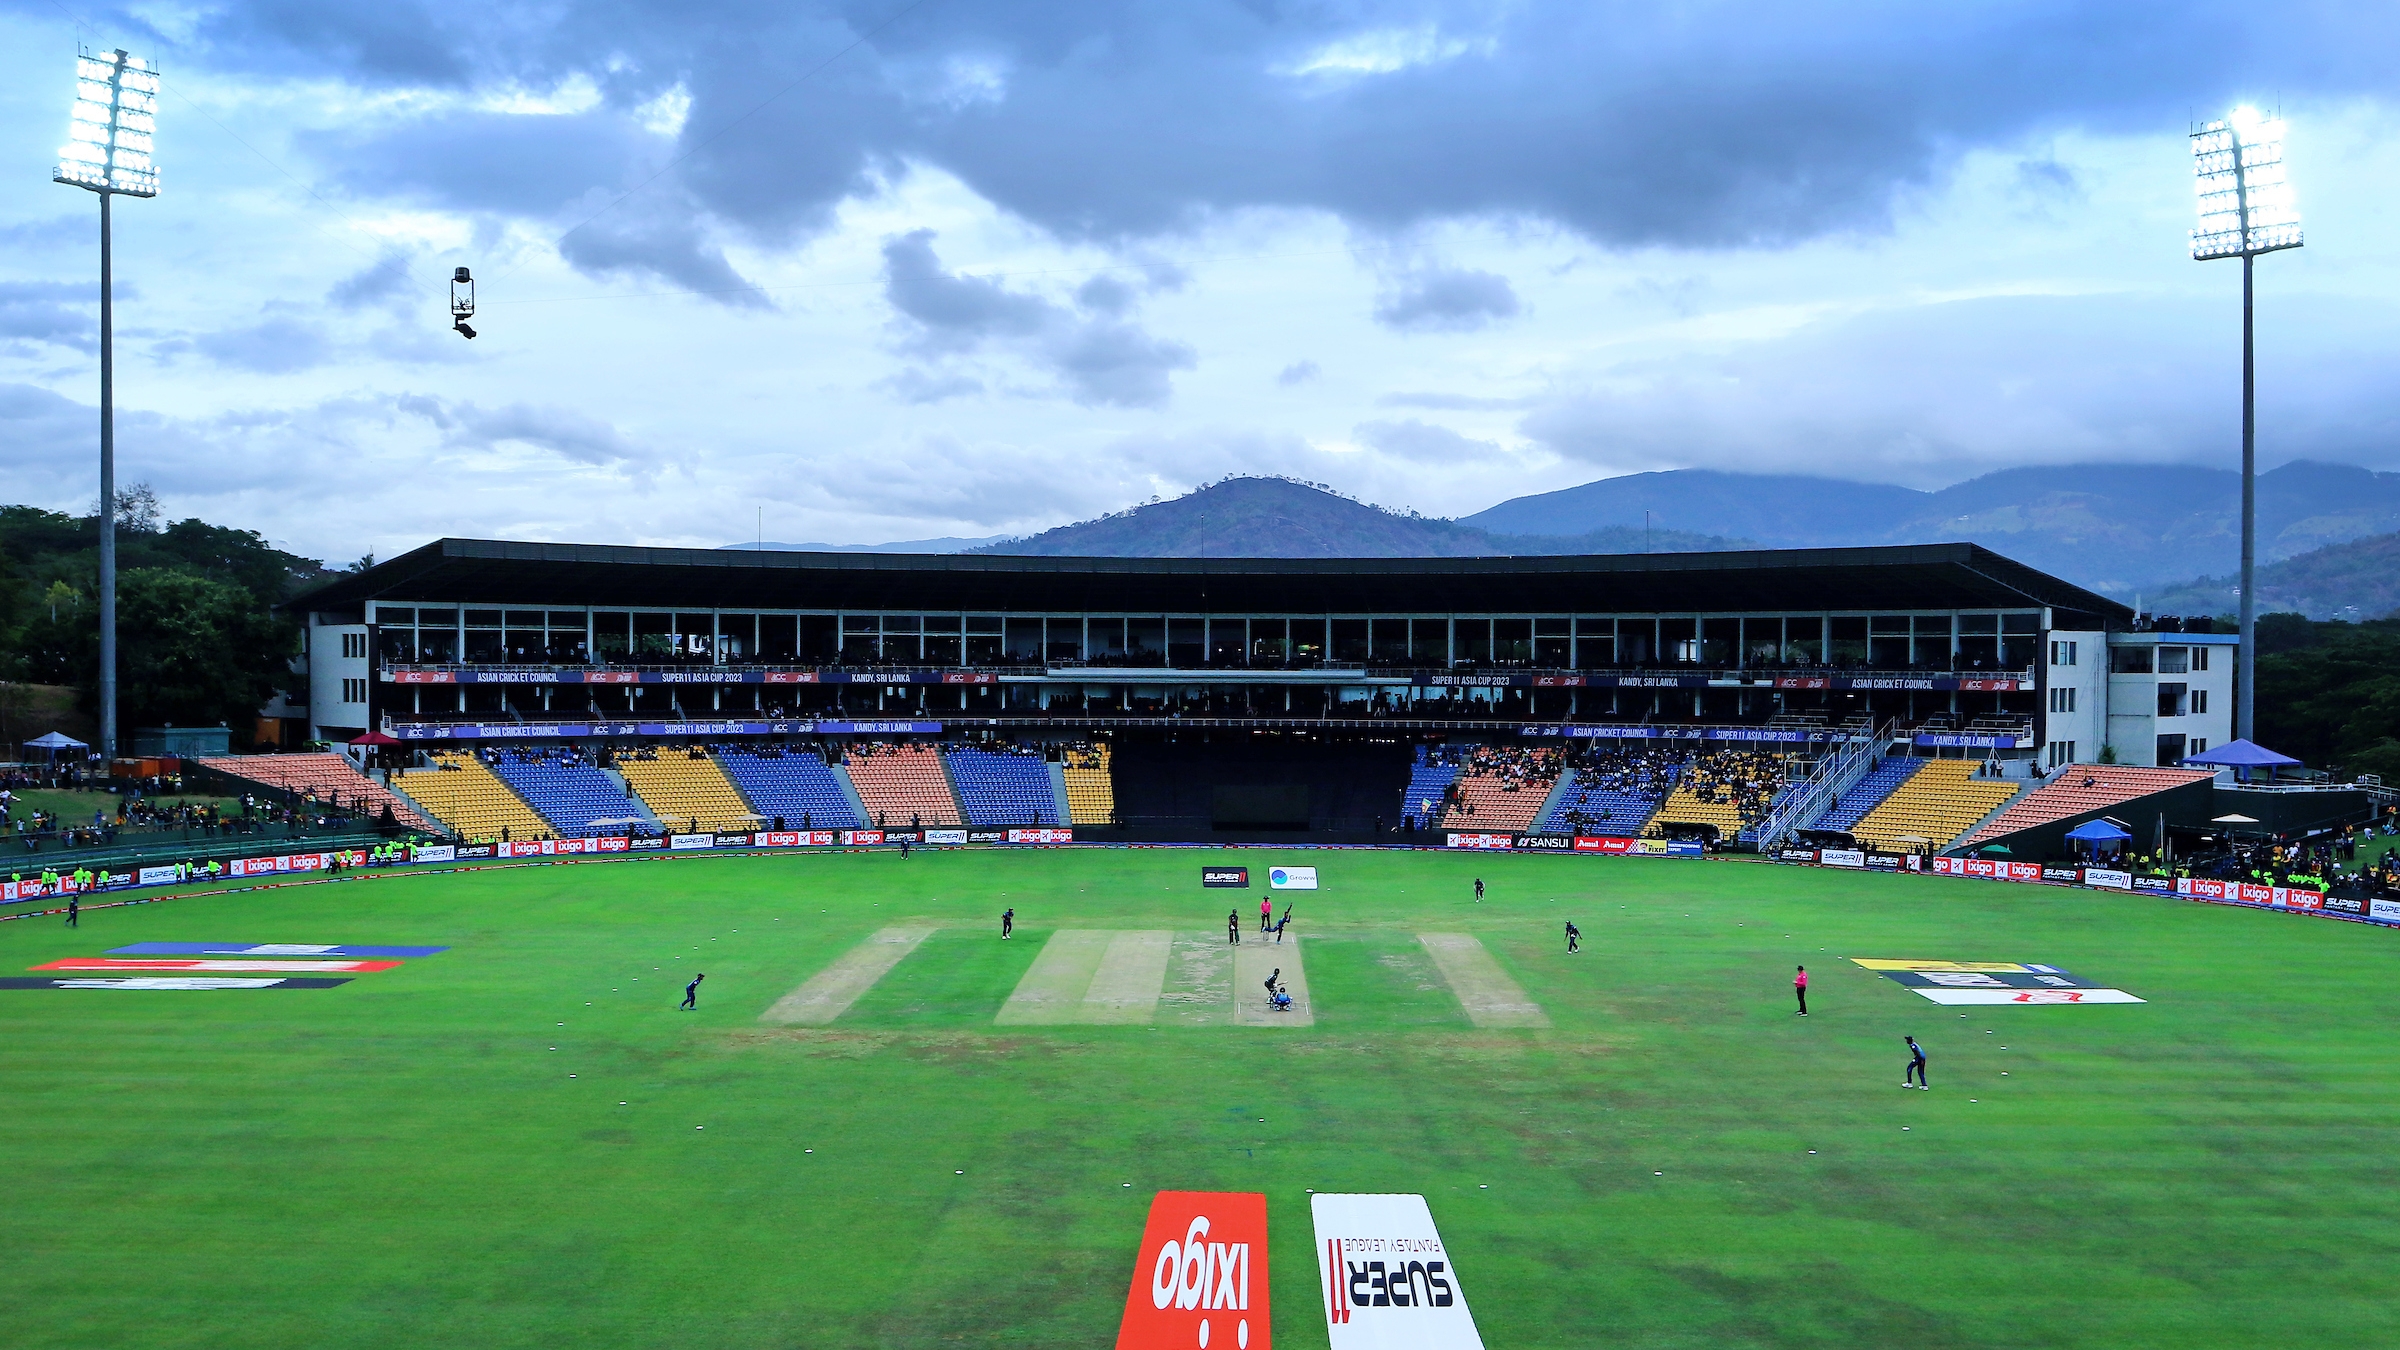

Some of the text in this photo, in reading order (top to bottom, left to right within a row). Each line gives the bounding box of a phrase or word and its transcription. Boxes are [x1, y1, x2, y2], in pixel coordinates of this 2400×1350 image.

[477, 672, 559, 682] ASIAN CRICKET COUNCIL
[693, 673, 709, 682] ASIA
[710, 673, 724, 682] CUP
[724, 673, 743, 682] 2023
[852, 673, 911, 683] KANDY, SRI LANKA
[1461, 676, 1477, 685] ASIA
[1478, 676, 1491, 685] CUP
[1492, 676, 1510, 686] 2023
[1644, 677, 1655, 686] SRI
[1655, 677, 1678, 687] LANKA
[1851, 679, 1934, 689] ASIAN CRICKET COUNCIL
[480, 726, 561, 737] ASIAN CRICKET COUNCIL
[695, 725, 712, 734] ASIA
[712, 725, 726, 734] CUP
[726, 725, 744, 734] 2023
[878, 723, 890, 732] SRI
[891, 723, 913, 732] LANKA
[1572, 728, 1648, 738] ASIAN CRICKET COUNCIL
[1745, 731, 1763, 741] ASIA
[1763, 731, 1777, 741] CUP
[1778, 732, 1796, 741] 2023
[1970, 736, 1996, 747] LANKA
[771, 833, 795, 845] ixigo
[856, 831, 881, 844] ixigo
[1019, 829, 1041, 842] ixigo
[1050, 829, 1072, 842] ixigo
[1458, 834, 1480, 846] ixigo
[1489, 834, 1512, 847] ixigo
[514, 842, 540, 855] ixigo
[558, 840, 583, 852] ixigo
[601, 838, 625, 850] ixigo
[1530, 837, 1569, 848] SANSUI
[1577, 839, 1599, 848] Amul
[1603, 840, 1625, 849] Amul
[248, 859, 274, 872] ixigo
[292, 855, 318, 869] ixigo
[1967, 859, 1993, 875] ixigo
[2011, 863, 2038, 879] ixigo
[2195, 880, 2222, 896] ixigo
[2243, 886, 2270, 901] ixigo
[2291, 890, 2319, 907] ixigo
[1344, 1238, 1441, 1253] FANTASY LEAGUE
[1152, 1215, 1249, 1350] ixigo
